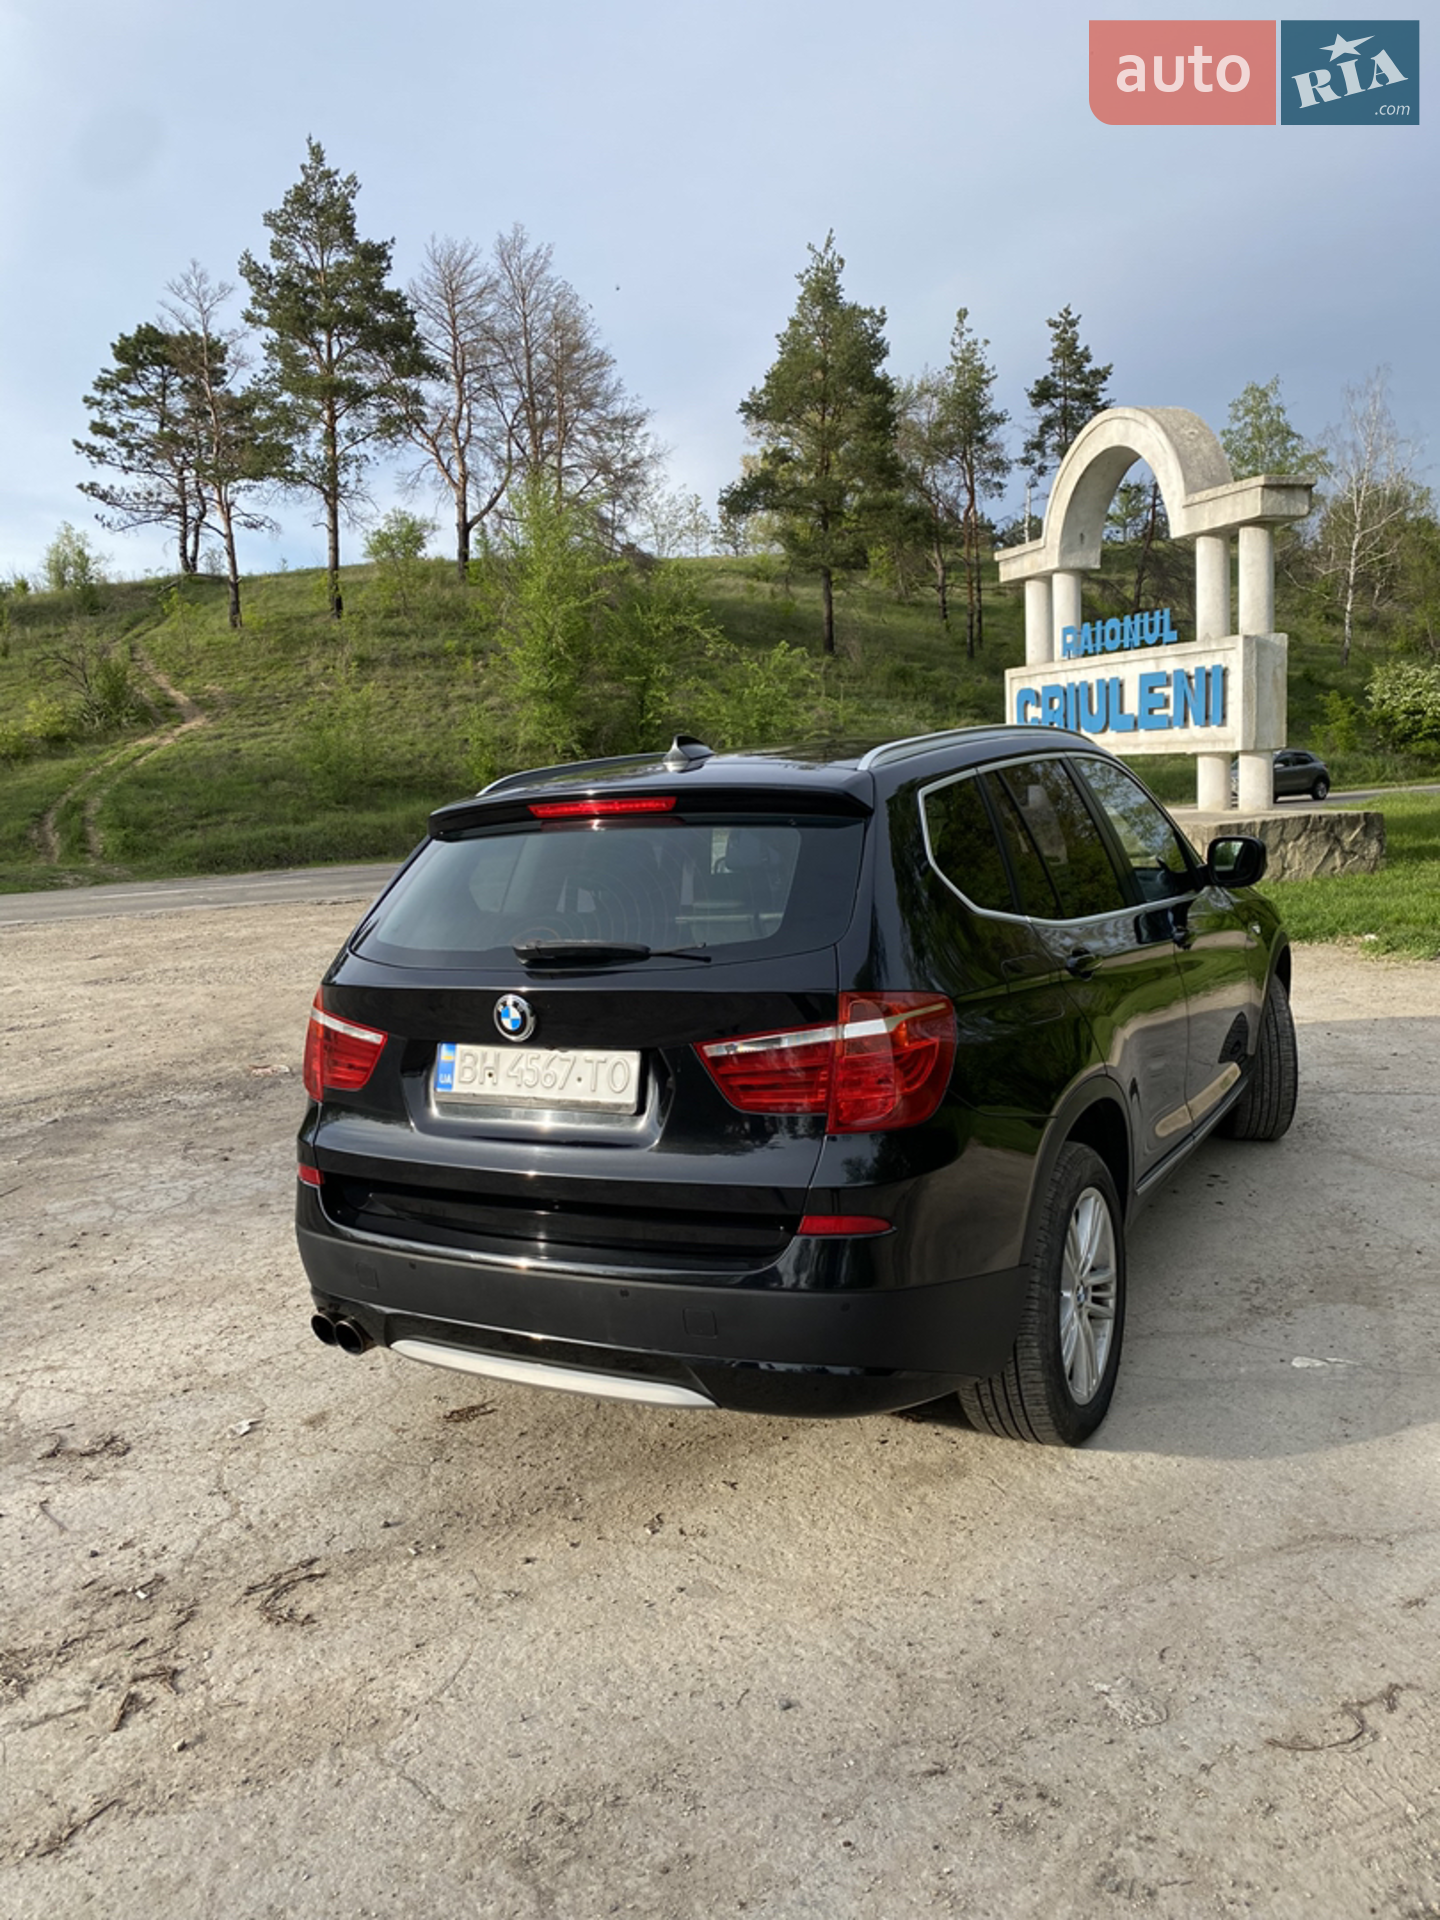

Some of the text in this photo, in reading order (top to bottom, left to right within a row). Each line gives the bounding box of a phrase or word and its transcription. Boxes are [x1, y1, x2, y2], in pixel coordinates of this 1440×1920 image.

[1061, 607, 1178, 659] RAIONUL
[1016, 664, 1226, 734] CRIULENI
[458, 1050, 631, 1093] BH 4567 TO
